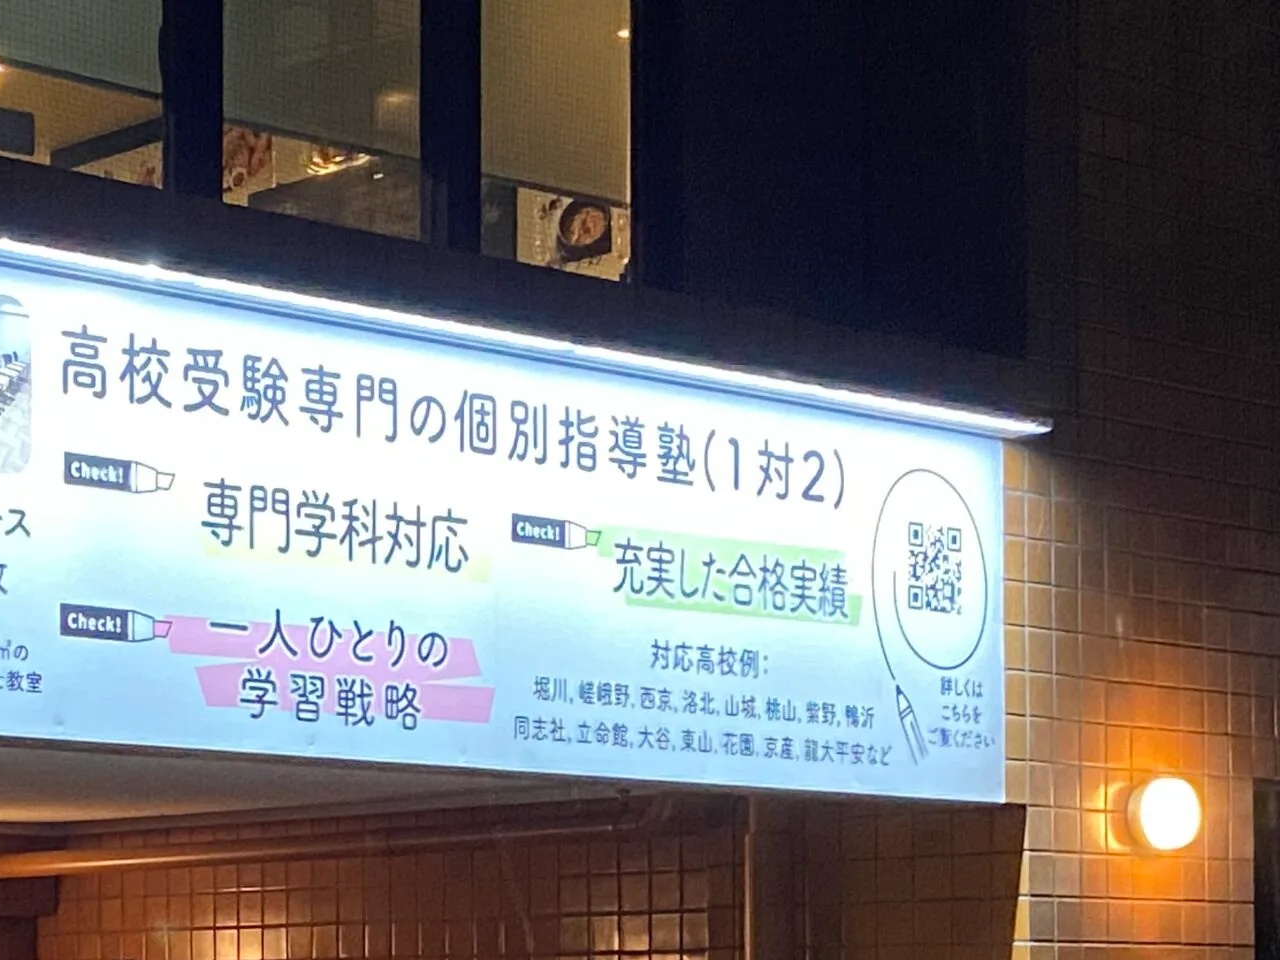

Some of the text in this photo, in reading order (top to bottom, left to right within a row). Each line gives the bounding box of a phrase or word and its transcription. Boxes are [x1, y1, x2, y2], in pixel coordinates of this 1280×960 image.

[60, 324, 845, 510] 高校受験専門の個別指導塾(1対2)
[69, 460, 123, 484] Check!
[201, 477, 470, 573] 専門学科対応
[515, 520, 561, 543] Check!
[612, 537, 849, 620] 充実した合格実績
[67, 611, 122, 634] Check!
[209, 608, 448, 668] 一人ひとりの
[940, 676, 984, 698] 詳しくは
[240, 668, 423, 732] 学習戦略
[942, 703, 982, 724] こちらを
[927, 727, 996, 749] ご覧ください
